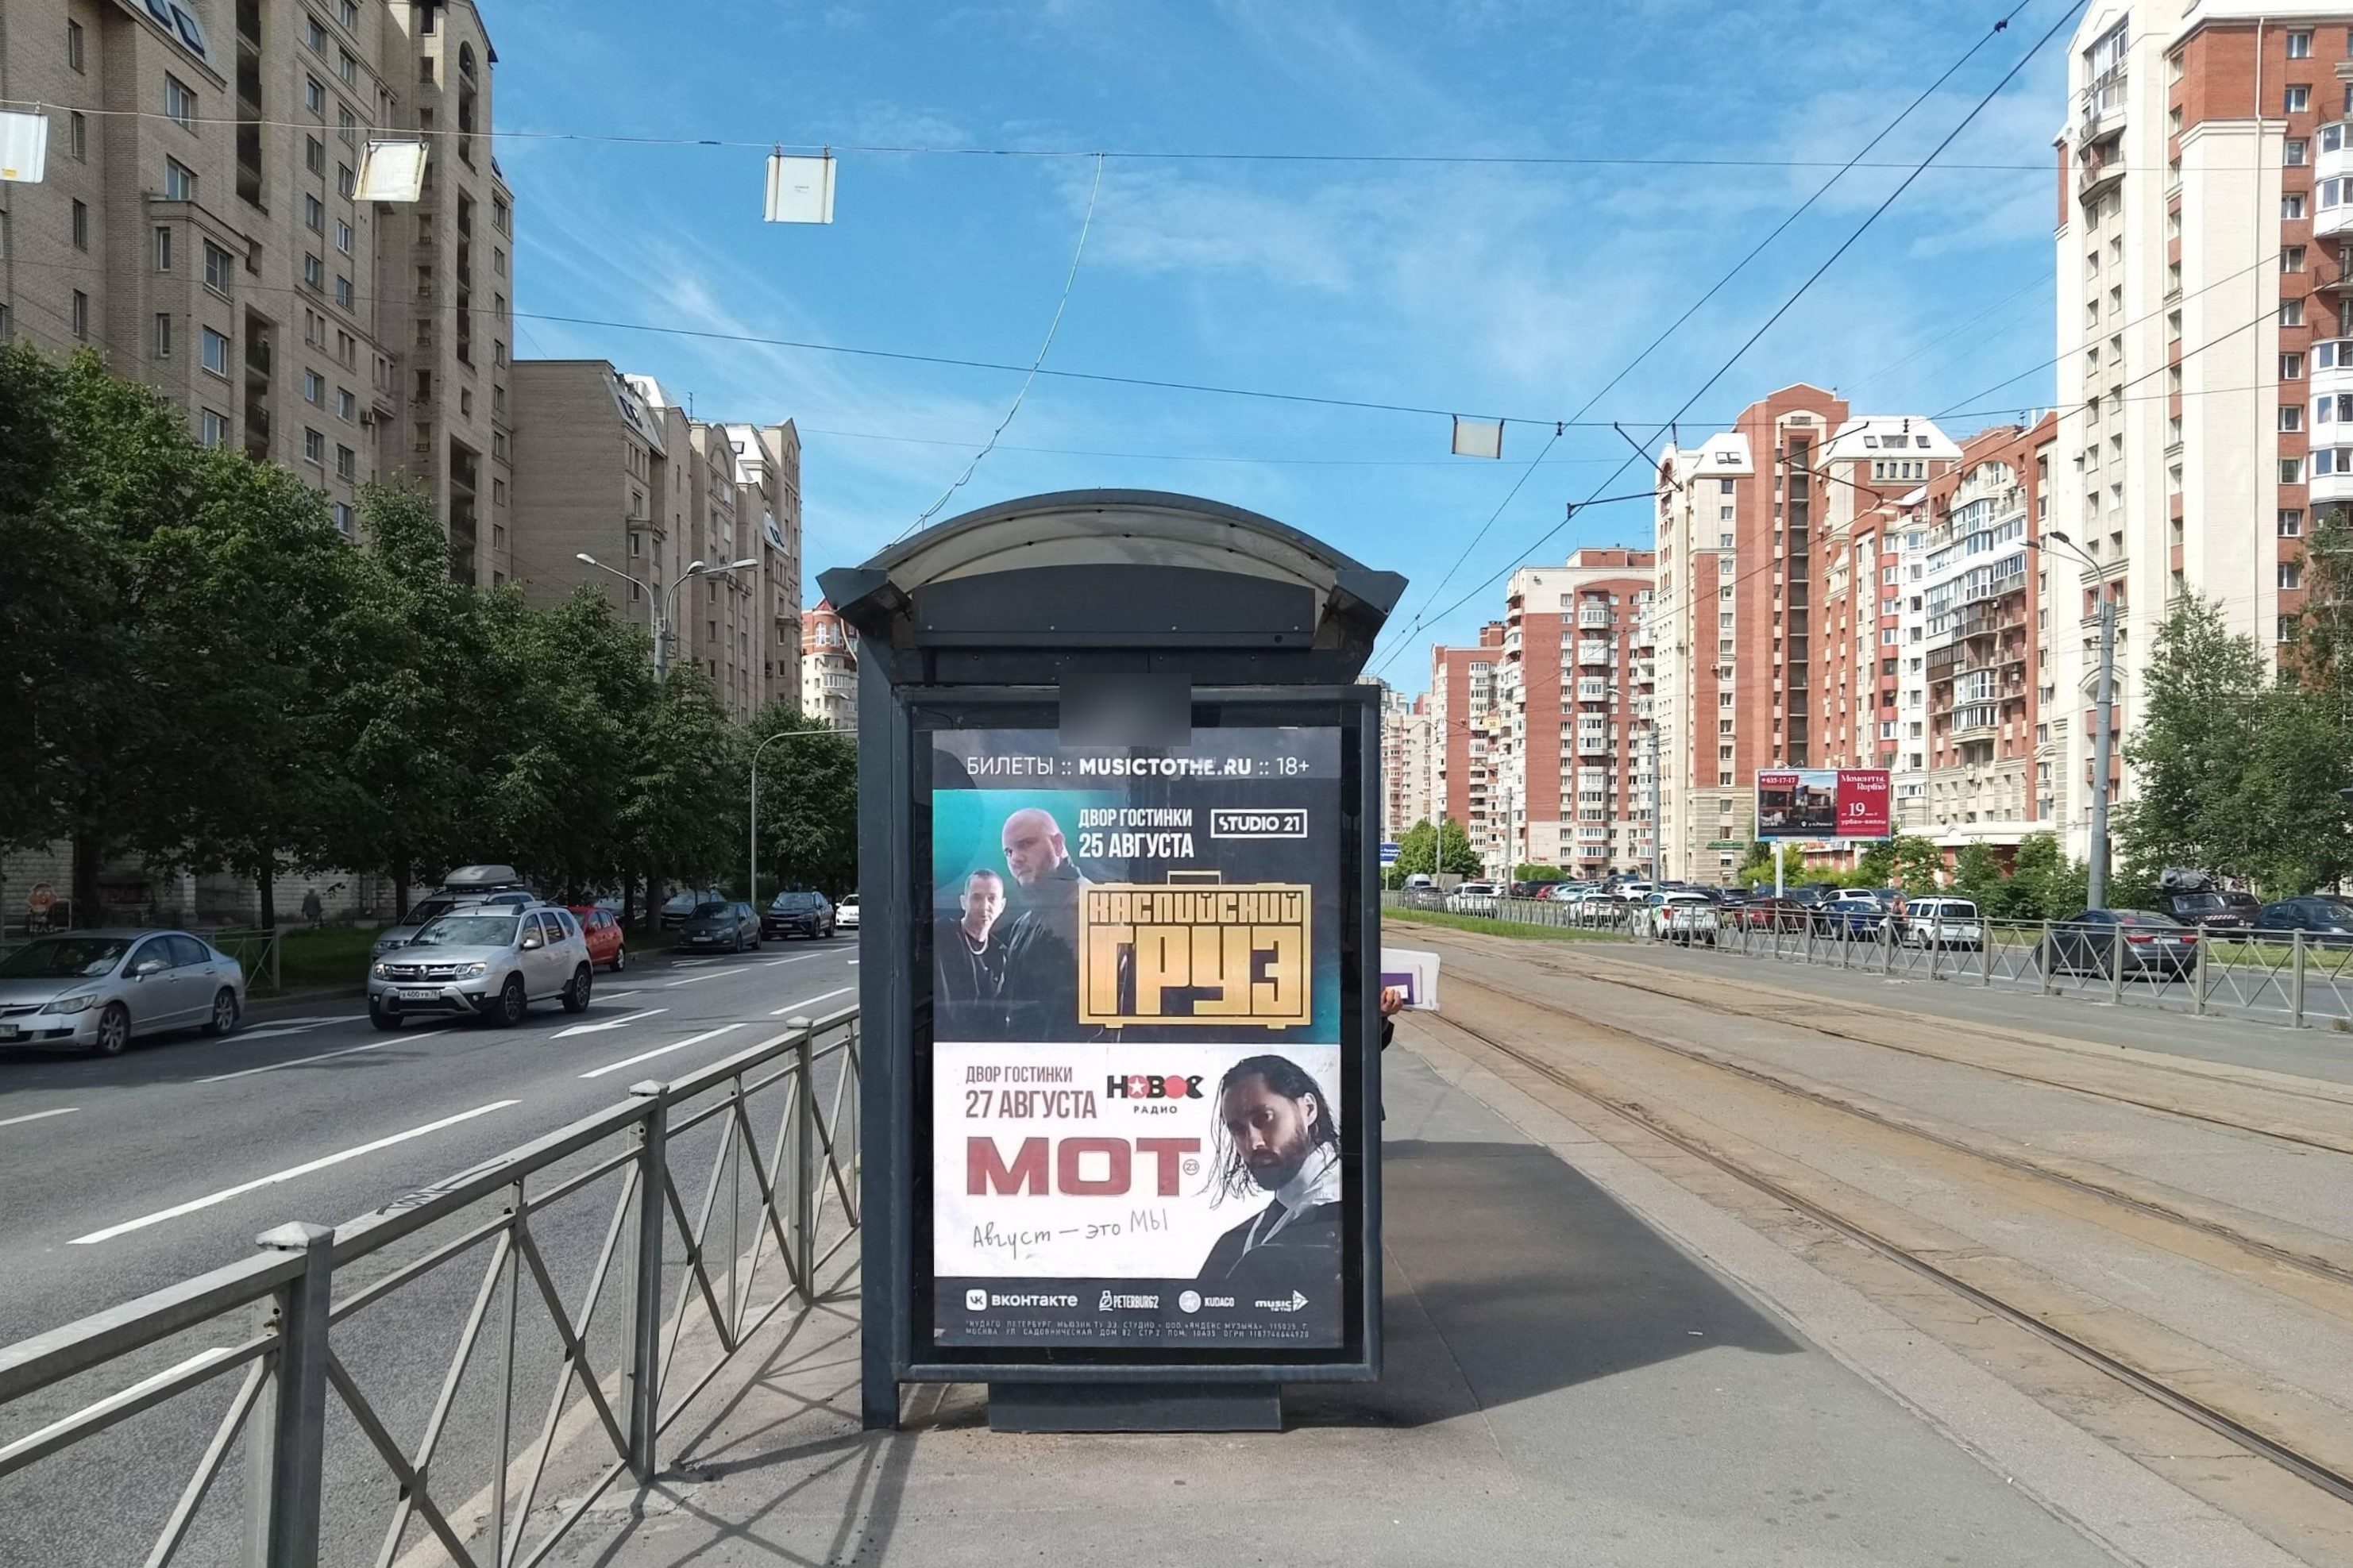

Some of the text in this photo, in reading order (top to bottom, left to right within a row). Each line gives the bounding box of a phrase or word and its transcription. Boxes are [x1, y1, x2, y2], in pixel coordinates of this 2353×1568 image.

[966, 757, 1053, 775] БИЛЕТЫ
[1078, 757, 1252, 776] MUSICTOTHE.RU
[1275, 757, 1310, 776] 18+
[1078, 808, 1193, 828] ДВОР ГОСТИНКИ
[1849, 802, 1866, 816] 19
[1218, 815, 1300, 832] STUDIO 21
[1079, 833, 1194, 857] 25 АВГУСТА
[1089, 892, 1302, 923] КАСПИЙСКИЙ
[1089, 926, 1302, 1015] ГРУЗ
[966, 1065, 1072, 1084] ДВОР ГОСТИНКИ
[966, 1089, 1097, 1119] 27 АВГУСТА
[1133, 1105, 1178, 1115] РАДИО
[966, 1136, 1201, 1196] МОТ
[1186, 1162, 1198, 1172] 23
[973, 1222, 1051, 1259] Август
[1086, 1223, 1121, 1239] это
[1130, 1208, 1168, 1232] МЫ
[1006, 1320, 1051, 1328] ПЕТЕРБУРГ
[1100, 1328, 1117, 1337] ДОМ
